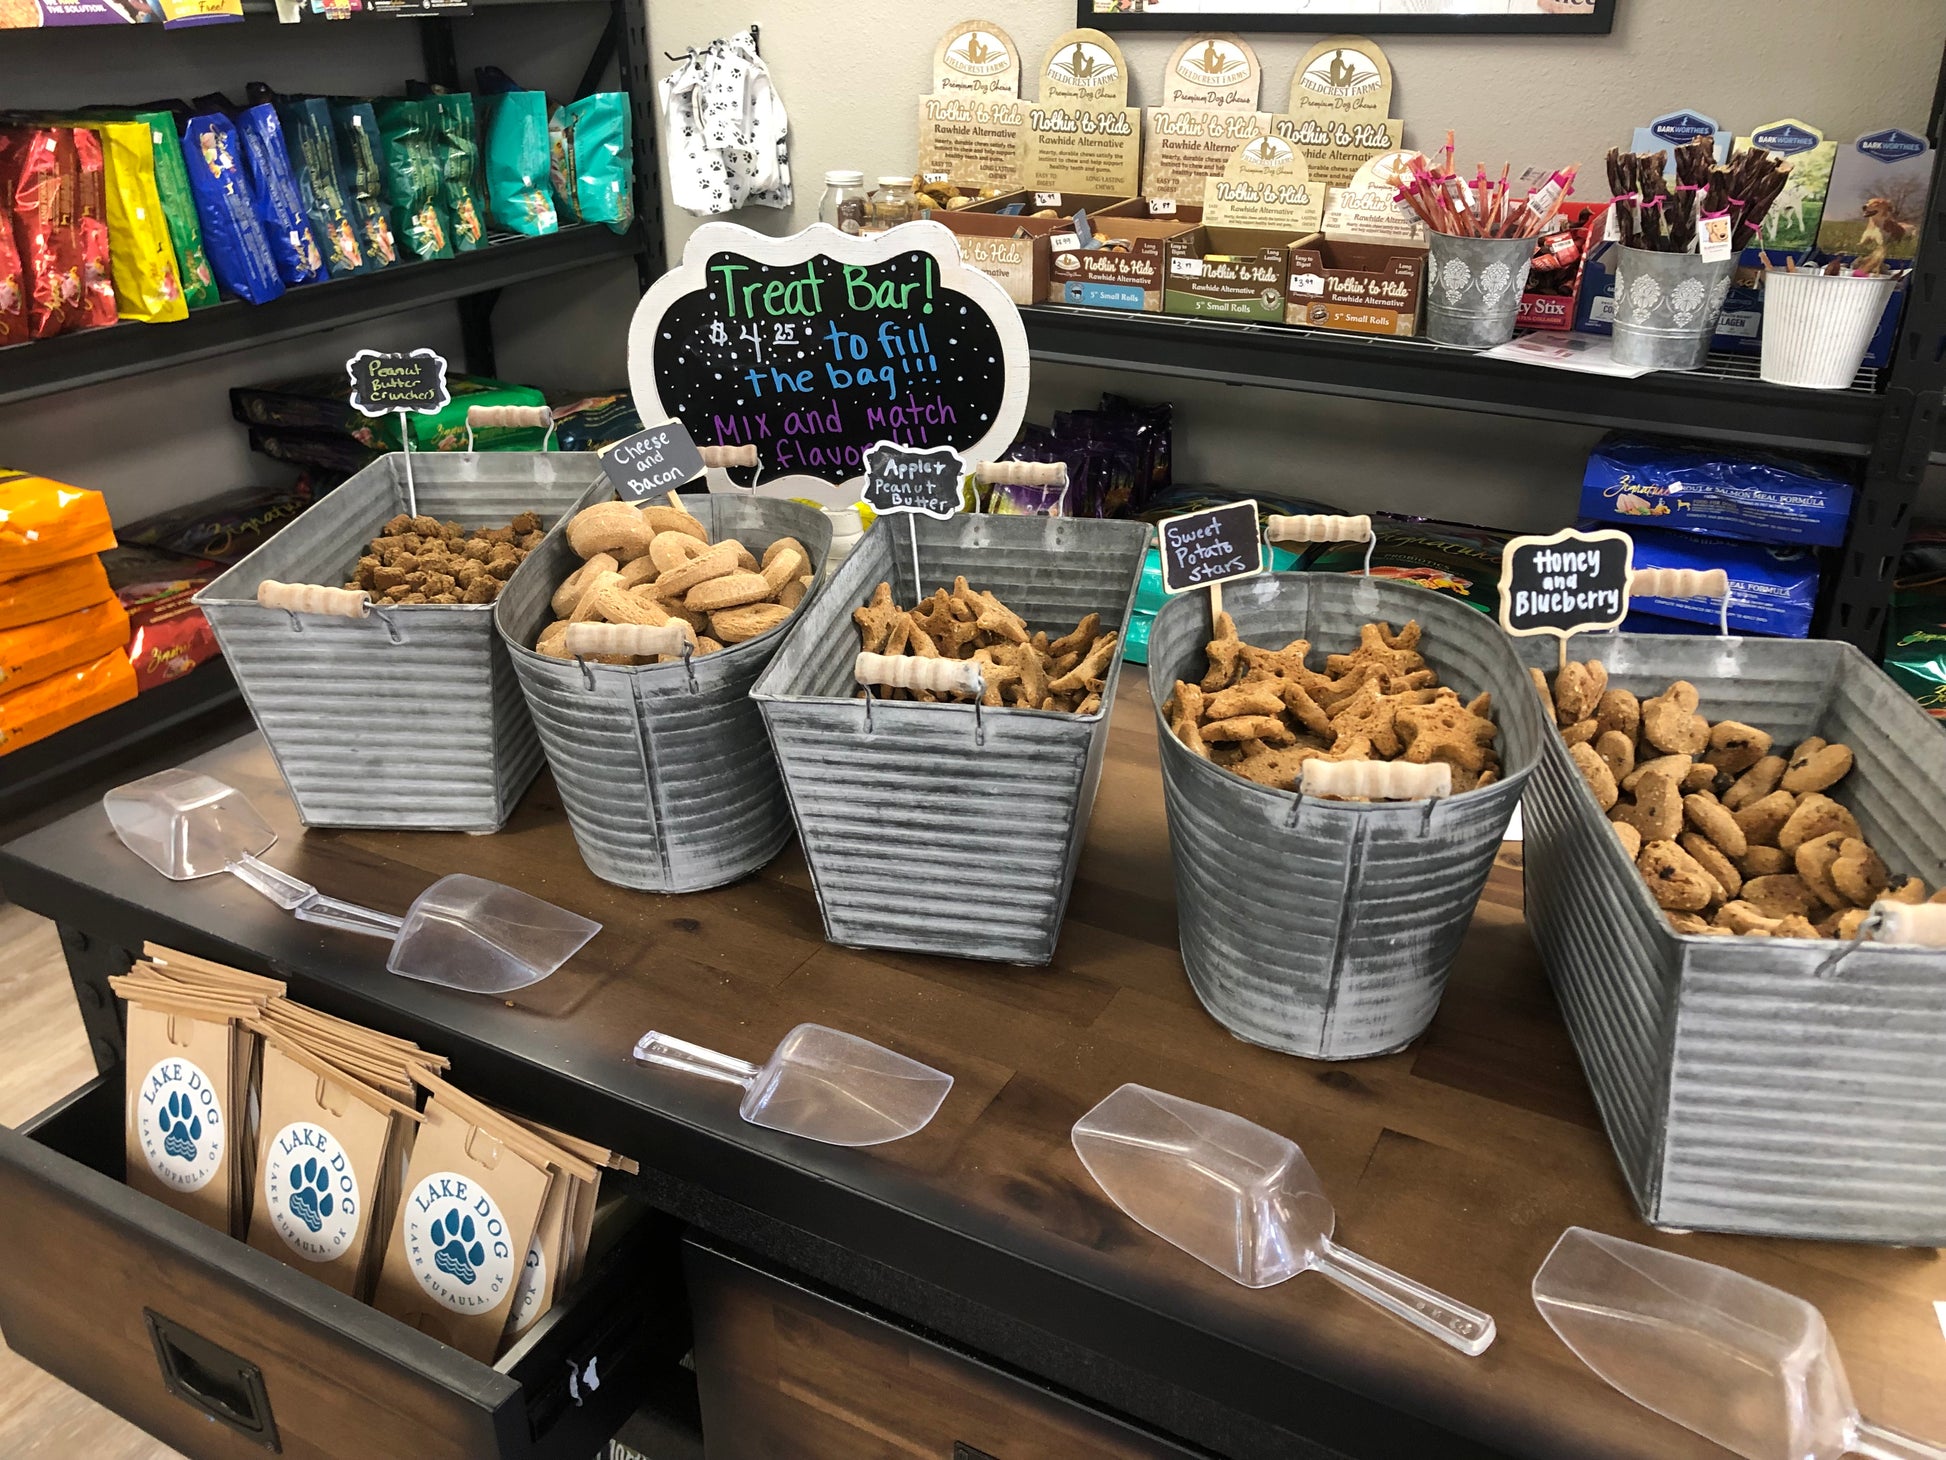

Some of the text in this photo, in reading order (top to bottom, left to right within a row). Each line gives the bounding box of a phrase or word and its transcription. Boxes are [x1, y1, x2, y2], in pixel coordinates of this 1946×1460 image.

[1047, 69, 1119, 86] FIELDCREST FARMS
[1179, 66, 1248, 84] FIELDCREST FARMS
[942, 78, 973, 91] Premium
[973, 79, 989, 94] Dog
[1079, 88, 1093, 101] Dog
[1300, 77, 1381, 96] FIELDCREST FARMS
[1173, 90, 1250, 106] Premium Dog Chews
[1300, 96, 1377, 112] Premium Dog Chews
[926, 100, 1023, 125] Nothin' to Hide
[1030, 108, 1132, 136] Nothin' to Hide
[935, 125, 1016, 138] Rawhide Alternative
[1154, 112, 1260, 139] Nothin' to Hide
[1277, 120, 1392, 149] Nothin' to Hide
[1039, 135, 1124, 148] Rawhide Alternative
[1162, 139, 1201, 150] Rawhide
[1217, 181, 1310, 205] Nothin' to Hide
[1341, 192, 1392, 212] Nothin'
[1231, 205, 1294, 215] Rawhide Alternative
[975, 242, 988, 262] to
[989, 243, 1022, 264] Hide
[1267, 249, 1279, 257] Long
[1083, 256, 1155, 275] Nothin' to Hide
[1202, 263, 1239, 280] Nothin'
[1239, 266, 1251, 280] to
[1252, 267, 1277, 283] Hide
[1395, 269, 1414, 277] Lasting
[710, 258, 933, 319] Treat Bar!
[1089, 273, 1116, 281] Rawhide
[1116, 275, 1151, 284] Alternative
[1328, 276, 1409, 297] Nothin' to Hide
[1100, 291, 1119, 300] Small
[1121, 293, 1138, 302] Rolls
[1192, 283, 1255, 295] Rawhide Alternative
[1206, 302, 1230, 312] Small
[1231, 304, 1250, 313] Rolls
[1332, 294, 1363, 303] Rawhide
[1364, 296, 1404, 307] Alternative
[1535, 298, 1565, 315] Stix
[1334, 313, 1344, 321] 5"
[1345, 314, 1368, 323] Small
[1369, 315, 1389, 325] Rolls
[824, 320, 869, 361] to
[877, 321, 930, 359] fill
[368, 360, 422, 377] Peanut
[371, 378, 421, 392] Butter
[744, 367, 815, 398] the
[784, 399, 843, 435] and
[614, 432, 670, 465] Cheese
[636, 450, 665, 472] and
[883, 458, 932, 480] Apple
[627, 467, 685, 496] Bacon
[875, 479, 937, 495] Peanut
[891, 493, 948, 512] Butter
[1715, 487, 1751, 499] SALMON
[1752, 492, 1779, 502] MEAL
[1779, 495, 1825, 507] FORMULA
[1167, 516, 1223, 547] Sweet
[1175, 538, 1233, 569] Potato
[1533, 549, 1600, 578] Honey
[1542, 573, 1578, 591] and
[1747, 583, 1791, 598] FORMULA
[1515, 588, 1619, 617] Blueberry
[144, 1064, 219, 1125] LAKE DOG
[143, 1119, 157, 1157] LAKE
[209, 1142, 219, 1160] OK
[279, 1128, 356, 1215] LAKE DOG
[271, 1162, 281, 1203] LAKE
[333, 1228, 347, 1245] OK
[415, 1179, 509, 1259] LAKE DOG
[410, 1222, 424, 1266] LAKE
[490, 1274, 504, 1293] OK
